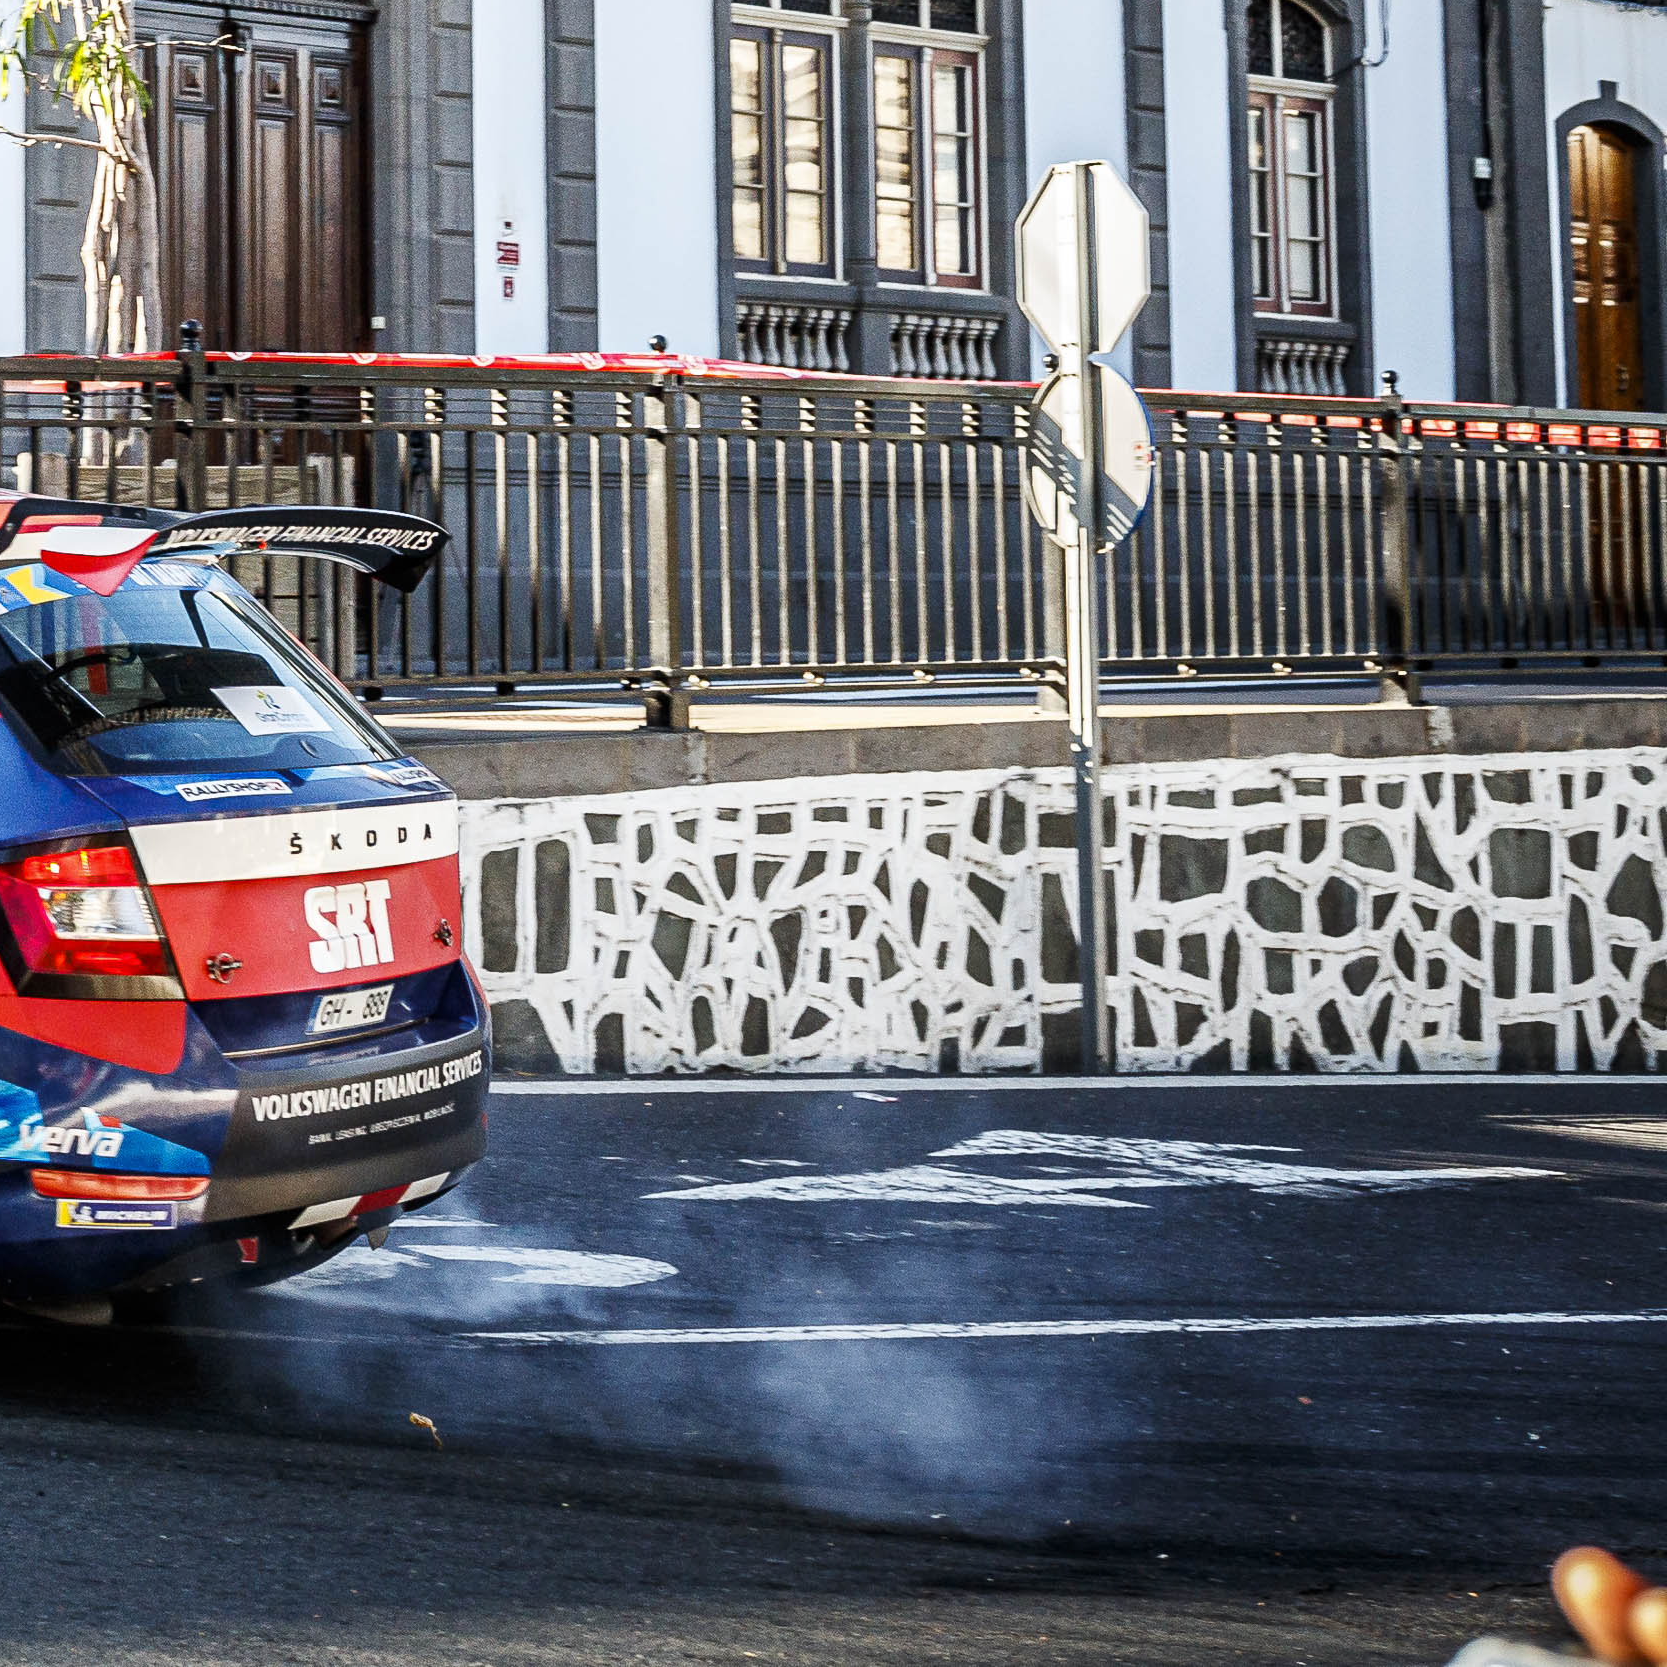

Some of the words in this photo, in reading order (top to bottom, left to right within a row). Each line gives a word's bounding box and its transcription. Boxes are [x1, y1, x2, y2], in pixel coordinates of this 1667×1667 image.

[277, 525, 367, 544] FINANCIAL
[366, 527, 440, 552] SERVICES
[182, 781, 267, 797] RALLYSHOP
[290, 823, 433, 855] ŠKODA
[303, 877, 396, 974] SRT
[252, 1081, 372, 1122] VOLKSWAGEN
[374, 1065, 442, 1103] FINANCIAL
[442, 1049, 482, 1087] SERVICES
[19, 1122, 123, 1158] verva
